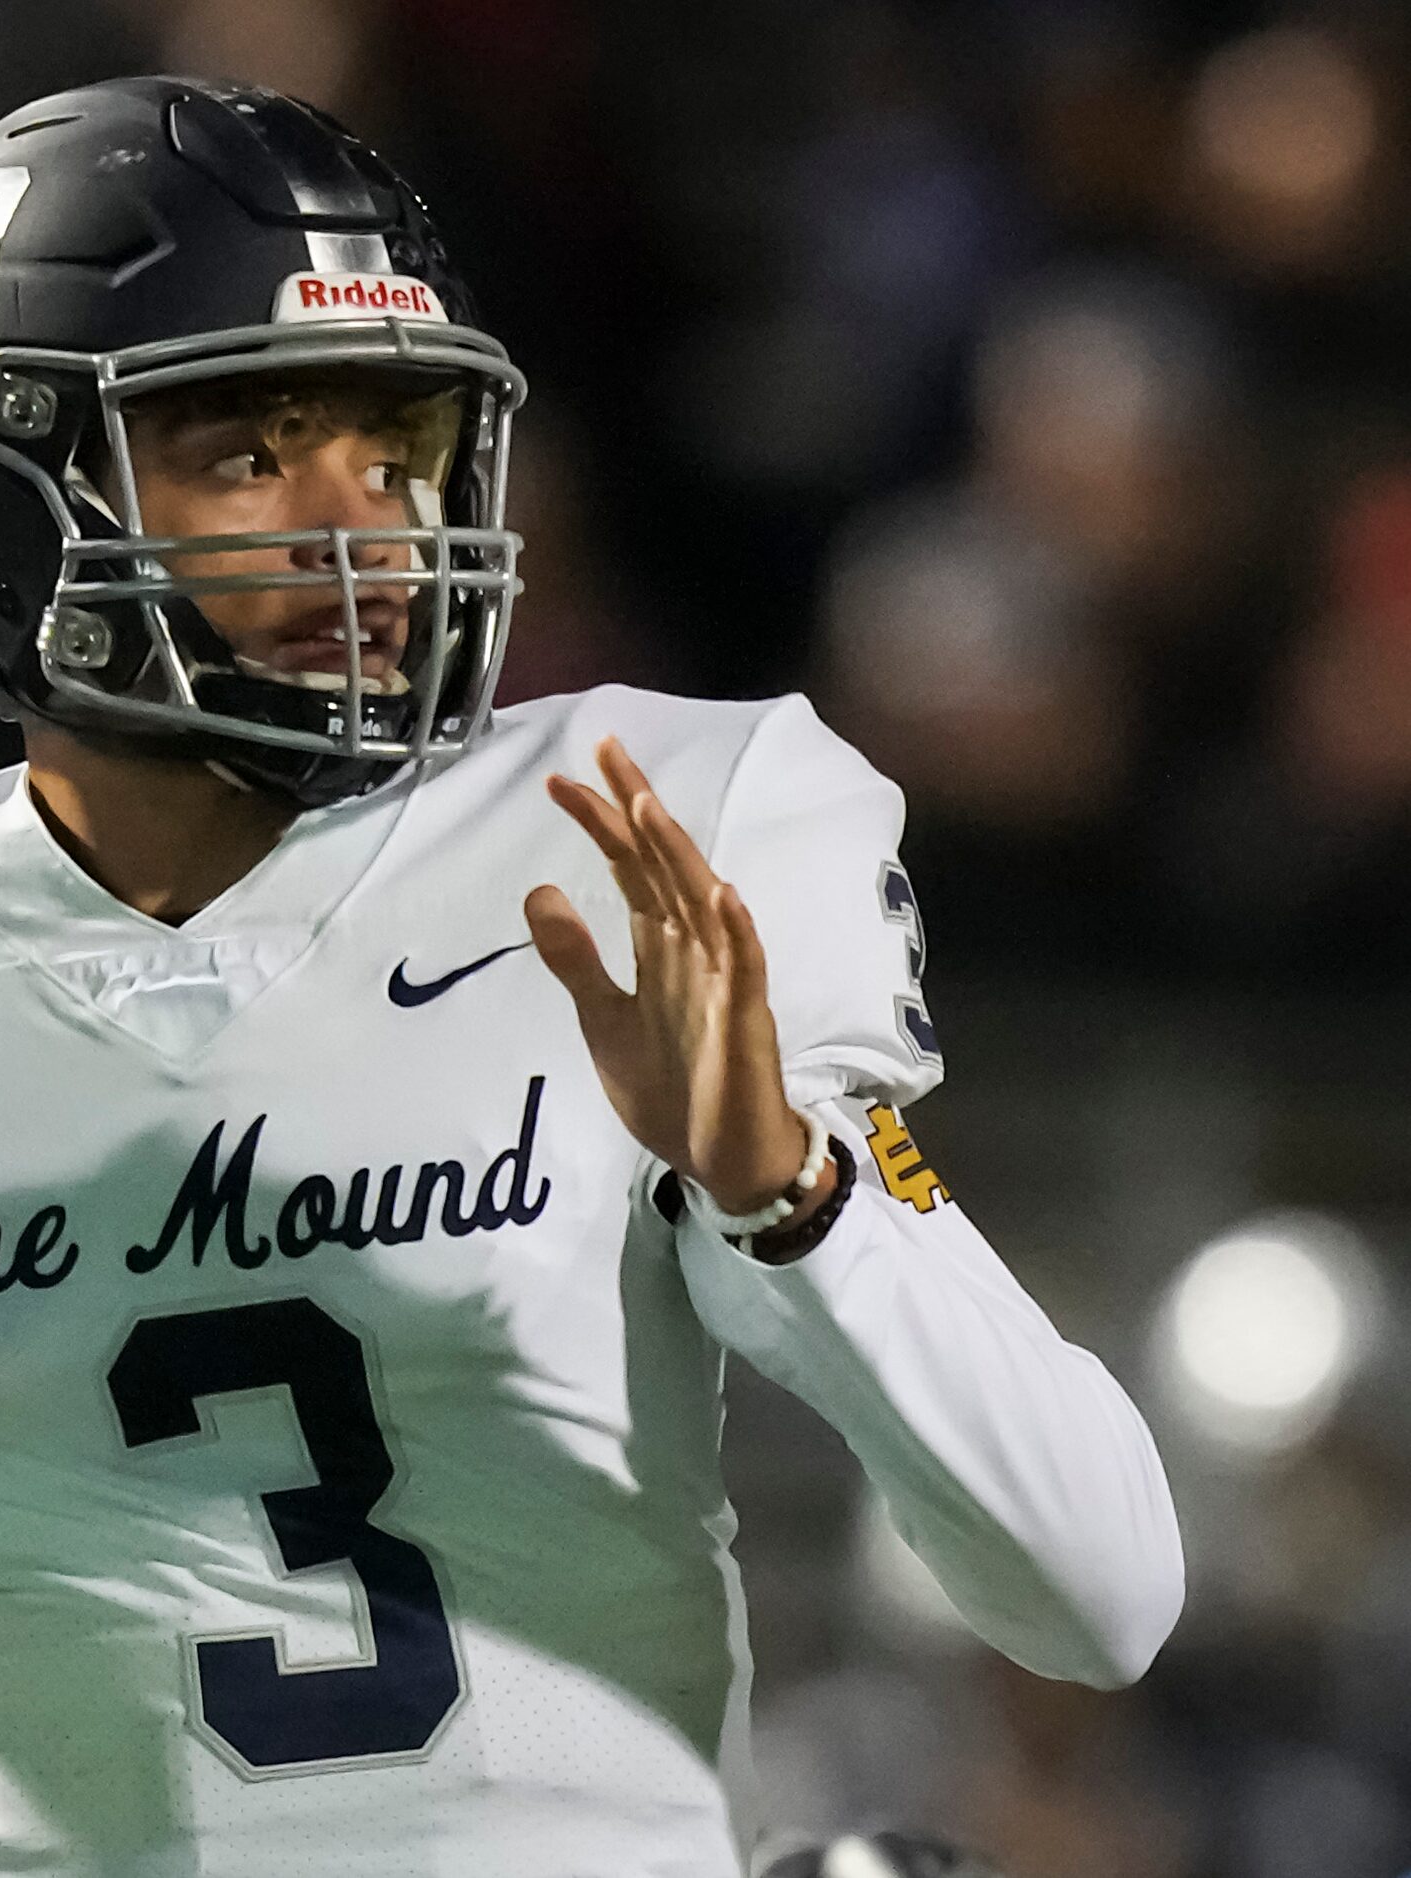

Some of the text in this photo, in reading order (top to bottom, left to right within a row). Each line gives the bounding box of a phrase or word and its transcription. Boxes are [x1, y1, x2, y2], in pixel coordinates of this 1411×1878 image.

[298, 279, 431, 314] Riddell
[125, 1075, 551, 1273] Mound
[103, 1294, 468, 1776] 3
